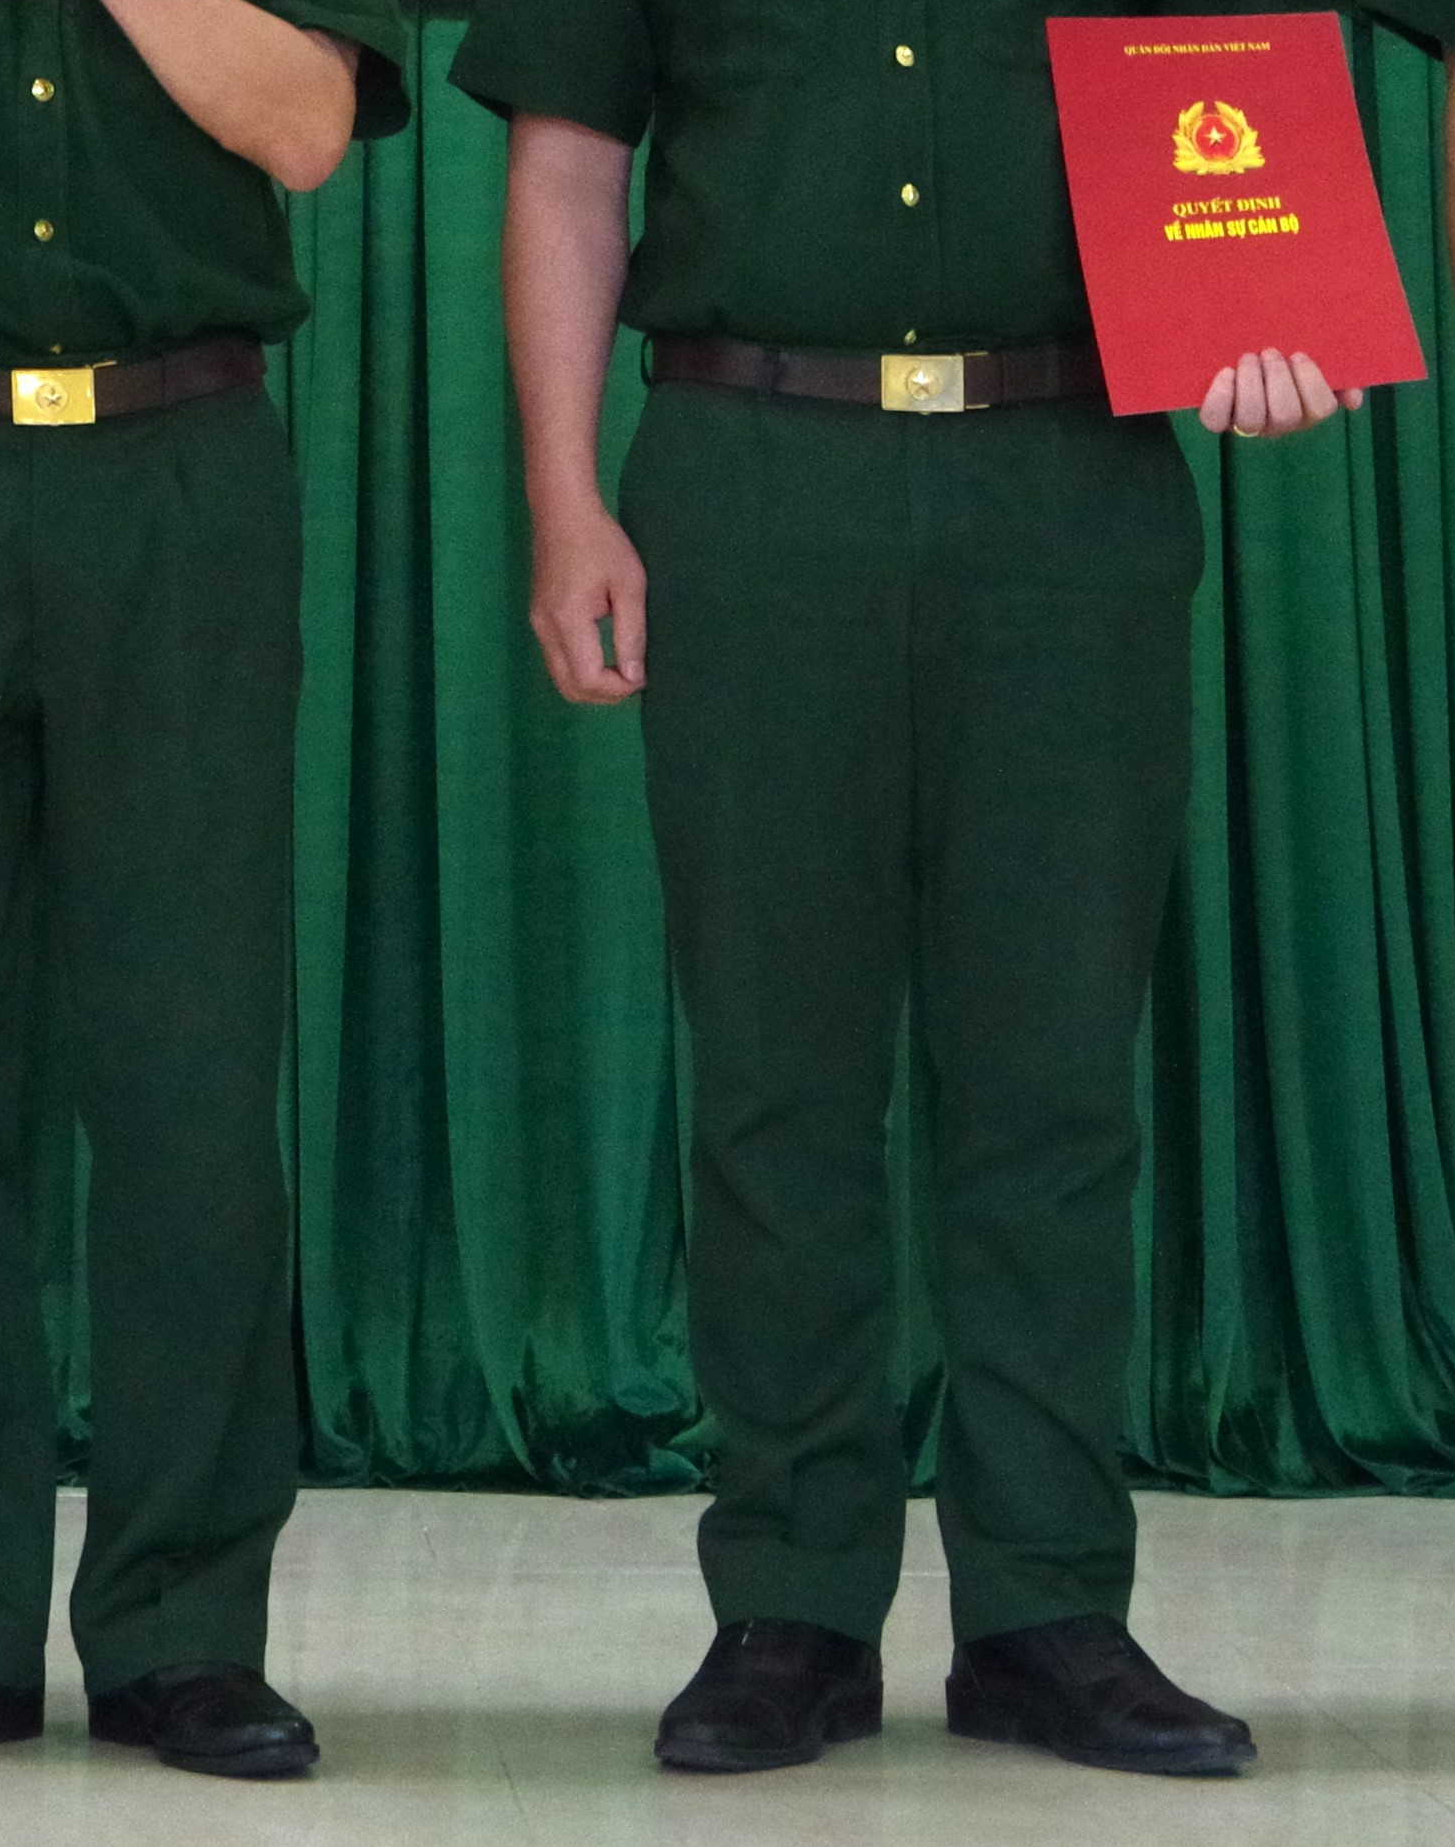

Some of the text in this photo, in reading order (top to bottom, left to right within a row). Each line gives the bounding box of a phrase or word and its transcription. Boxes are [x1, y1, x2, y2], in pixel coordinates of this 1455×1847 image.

[1172, 196, 1282, 218] QUYẾT ĐỊNH
[1184, 219, 1225, 239] NHÂN
[1247, 215, 1278, 235] CÁN
[1279, 212, 1300, 235] BỘ
